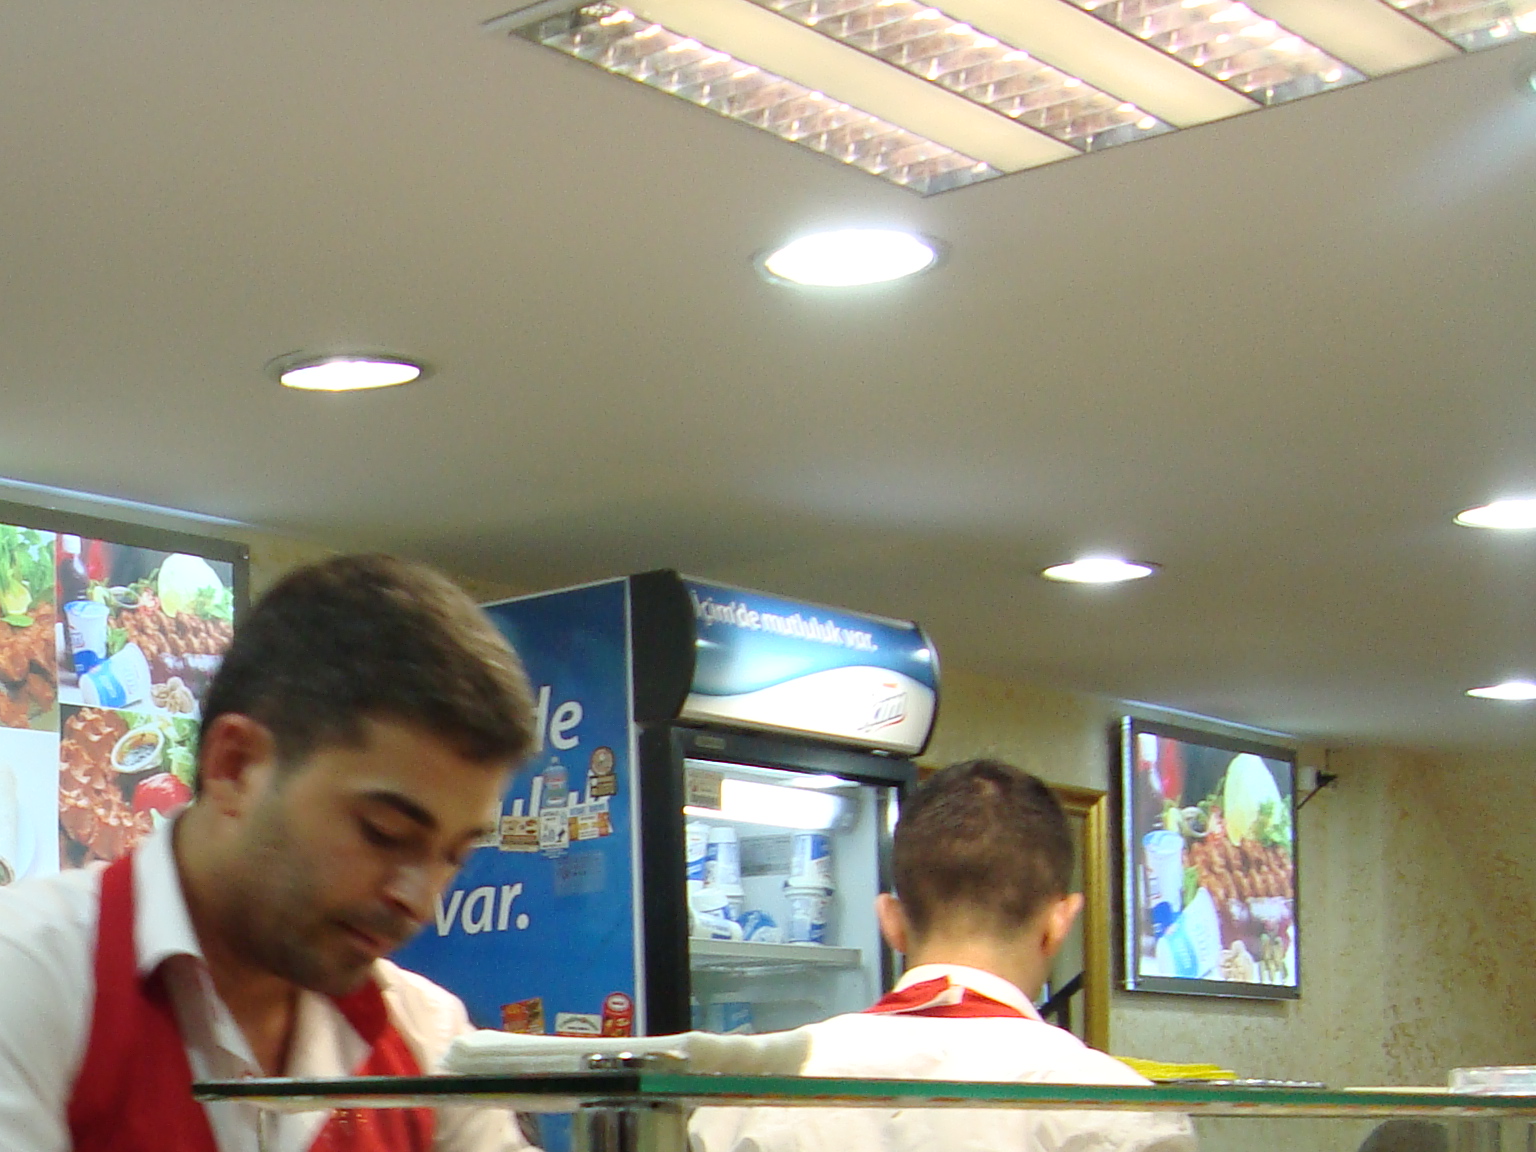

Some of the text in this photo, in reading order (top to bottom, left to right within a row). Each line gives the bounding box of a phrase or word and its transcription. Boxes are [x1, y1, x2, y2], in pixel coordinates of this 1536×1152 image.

[760, 612, 843, 647] mutluluk
[842, 629, 879, 652] var.
[434, 882, 530, 937] var.
